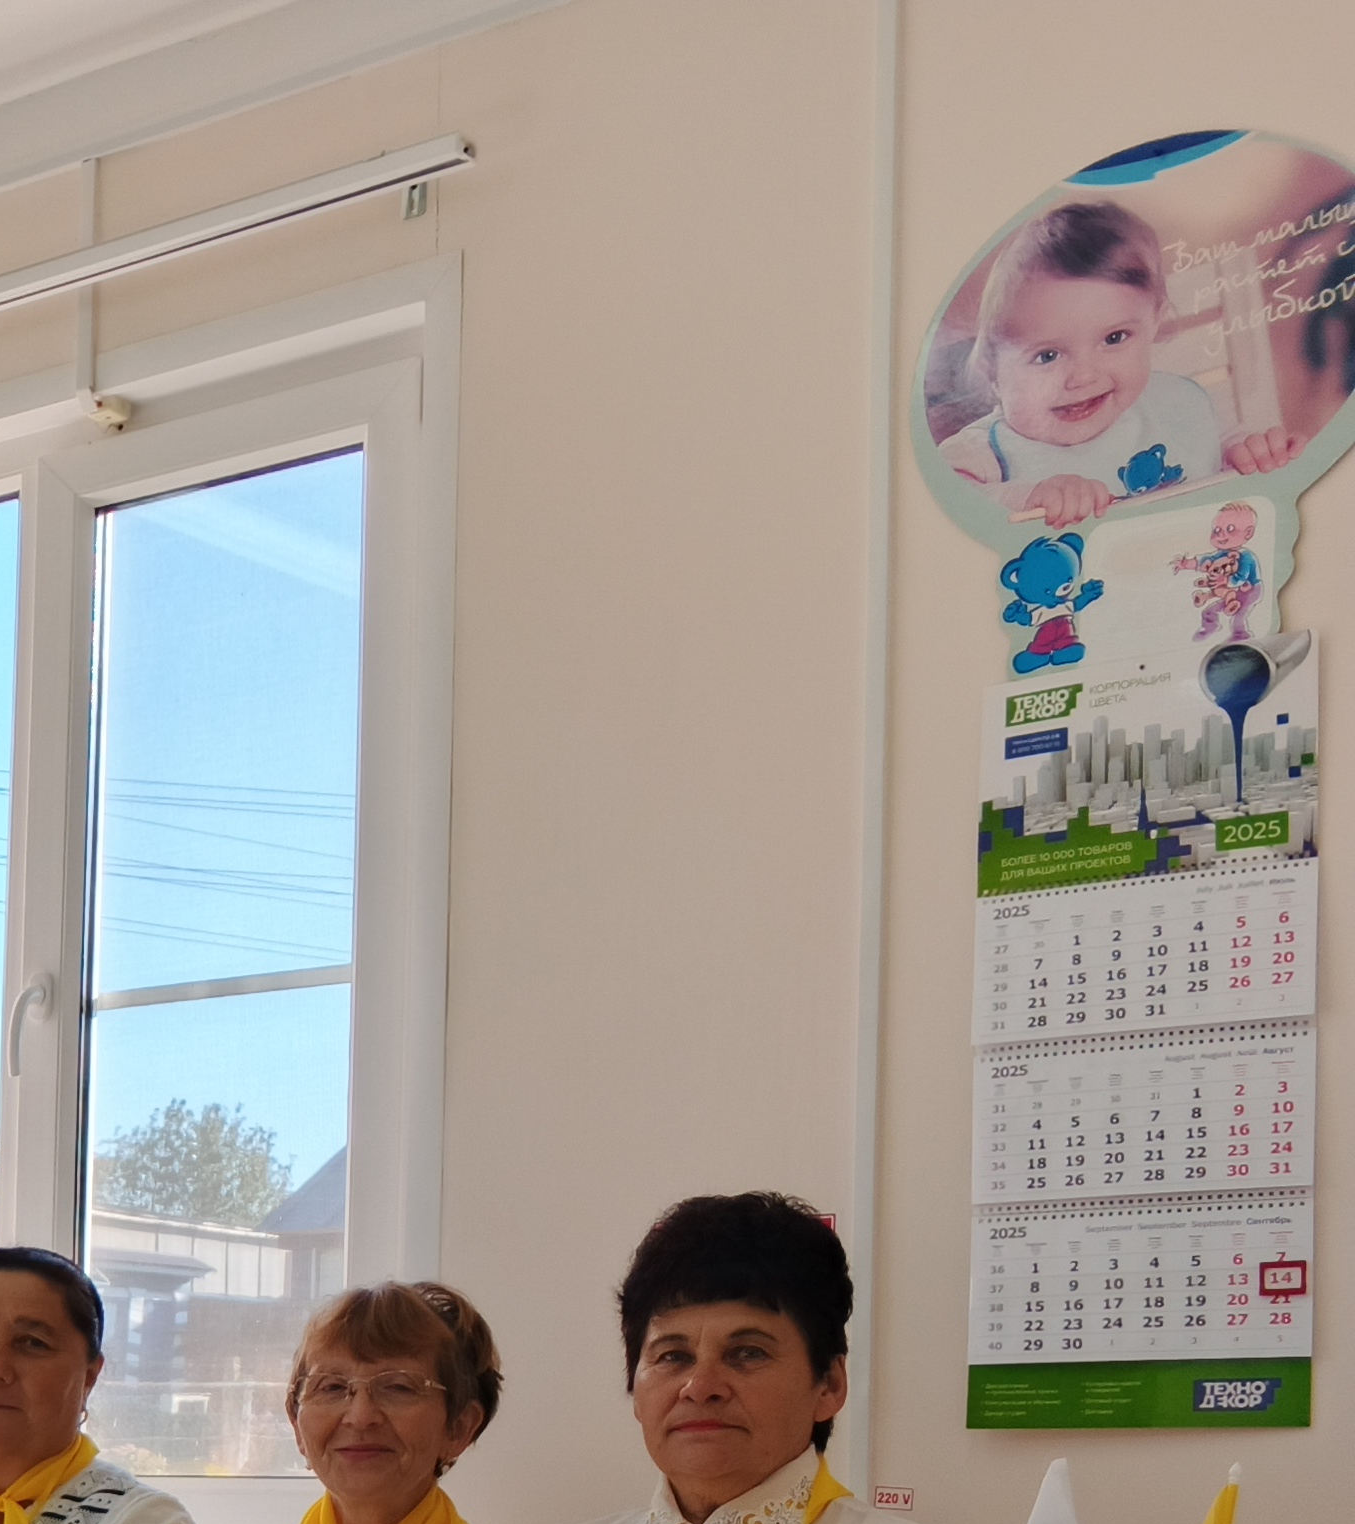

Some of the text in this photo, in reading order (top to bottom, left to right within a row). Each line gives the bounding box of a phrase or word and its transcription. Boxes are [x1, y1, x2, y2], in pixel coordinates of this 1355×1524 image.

[1164, 239, 1240, 273] Ваш
[1090, 672, 1172, 694] КОРПОРАЦИЯ
[1013, 688, 1070, 709] ТЕХНО
[1090, 694, 1127, 708] ЦВЕТА
[1010, 703, 1067, 724] ДЕКОР
[1223, 819, 1282, 843] 2025
[1000, 841, 1133, 868] БОЛЕЕ 10 000 ТОВАРОВ
[1000, 855, 1131, 881] ДЛЯ ВАШИХ ПРОЕКТОВ
[993, 903, 1030, 921] 2025
[1073, 934, 1081, 947] 1
[1112, 929, 1122, 942] 2
[1152, 925, 1163, 938] 3
[1193, 920, 1204, 932] 4
[1236, 915, 1247, 929] 5
[1278, 911, 1290, 924] 6
[1033, 958, 1044, 970] 7
[1071, 953, 1082, 966] 8
[1111, 949, 1122, 962] 9
[1147, 944, 1169, 958] 10
[1188, 940, 1209, 953] 11
[1231, 935, 1252, 949] 12
[1273, 930, 1295, 945] 13
[1029, 977, 1048, 990] 14
[1067, 971, 1087, 986] 15
[1107, 967, 1127, 982] 16
[1147, 963, 1168, 978] 17
[1188, 959, 1209, 973] 18
[1230, 955, 1252, 969] 19
[1272, 951, 1295, 965] 20
[1027, 996, 1047, 1009] 21
[1066, 991, 1086, 1005] 22
[1105, 987, 1127, 1001] 23
[1145, 983, 1167, 997] 24
[1187, 979, 1209, 993] 25
[1229, 975, 1251, 989] 26
[1271, 971, 1294, 985] 27
[1027, 1015, 1047, 1028] 28
[1065, 1011, 1087, 1025] 29
[1105, 1007, 1127, 1021] 30
[1145, 1003, 1166, 1017] 31
[991, 1064, 1029, 1079] 2025
[1193, 1087, 1202, 1099] 1
[1234, 1084, 1245, 1097] 2
[1277, 1080, 1288, 1094] 3
[1032, 1118, 1042, 1130] 4
[1070, 1115, 1081, 1129] 5
[1109, 1112, 1120, 1125] 6
[1150, 1109, 1161, 1122] 7
[1191, 1106, 1202, 1120] 8
[1233, 1103, 1245, 1117] 9
[1272, 1100, 1294, 1114] 10
[1028, 1138, 1046, 1151] 11
[1066, 1134, 1086, 1148] 12
[1105, 1131, 1125, 1145] 13
[1146, 1129, 1165, 1142] 14
[1186, 1126, 1207, 1139] 15
[1229, 1123, 1250, 1137] 16
[1271, 1120, 1294, 1134] 17
[1028, 1157, 1047, 1170] 18
[1066, 1154, 1085, 1167] 19
[1104, 1151, 1125, 1165] 20
[1144, 1149, 1165, 1162] 21
[1185, 1146, 1207, 1159] 22
[1227, 1143, 1250, 1157] 23
[1270, 1141, 1293, 1154] 24
[1026, 1176, 1047, 1190] 25
[1064, 1173, 1085, 1187] 26
[1103, 1171, 1124, 1184] 27
[1143, 1168, 1165, 1182] 28
[1185, 1166, 1207, 1179] 29
[1226, 1163, 1250, 1177] 30
[1269, 1161, 1292, 1175] 31
[989, 1226, 1027, 1240] 2025
[1032, 1262, 1040, 1274] 1
[1069, 1260, 1079, 1272] 2
[1108, 1258, 1119, 1271] 3
[1149, 1256, 1160, 1269] 4
[1191, 1254, 1201, 1267] 5
[1232, 1253, 1244, 1266] 6
[1275, 1251, 1286, 1262] 7
[1029, 1281, 1040, 1294] 8
[1068, 1279, 1079, 1292] 9
[1104, 1277, 1124, 1290] 10
[1144, 1276, 1165, 1289] 11
[1185, 1274, 1207, 1288] 12
[1227, 1272, 1249, 1286] 13
[1270, 1271, 1293, 1284] 14
[1025, 1300, 1045, 1313] 15
[1064, 1298, 1084, 1312] 16
[1103, 1297, 1124, 1310] 17
[1144, 1296, 1165, 1309] 18
[1185, 1294, 1207, 1307] 19
[1226, 1293, 1249, 1306] 20
[1024, 1319, 1044, 1332] 22
[1063, 1318, 1083, 1331] 23
[1102, 1317, 1123, 1330] 24
[1142, 1315, 1164, 1329] 25
[1184, 1314, 1207, 1327] 26
[1226, 1313, 1249, 1326] 27
[1269, 1312, 1292, 1325] 28
[1023, 1338, 1044, 1351] 29
[1062, 1337, 1083, 1351] 30
[1202, 1380, 1267, 1396] ТЕХНО
[1199, 1394, 1262, 1408] ДЕКОР
[877, 1491, 911, 1505] 220 V
